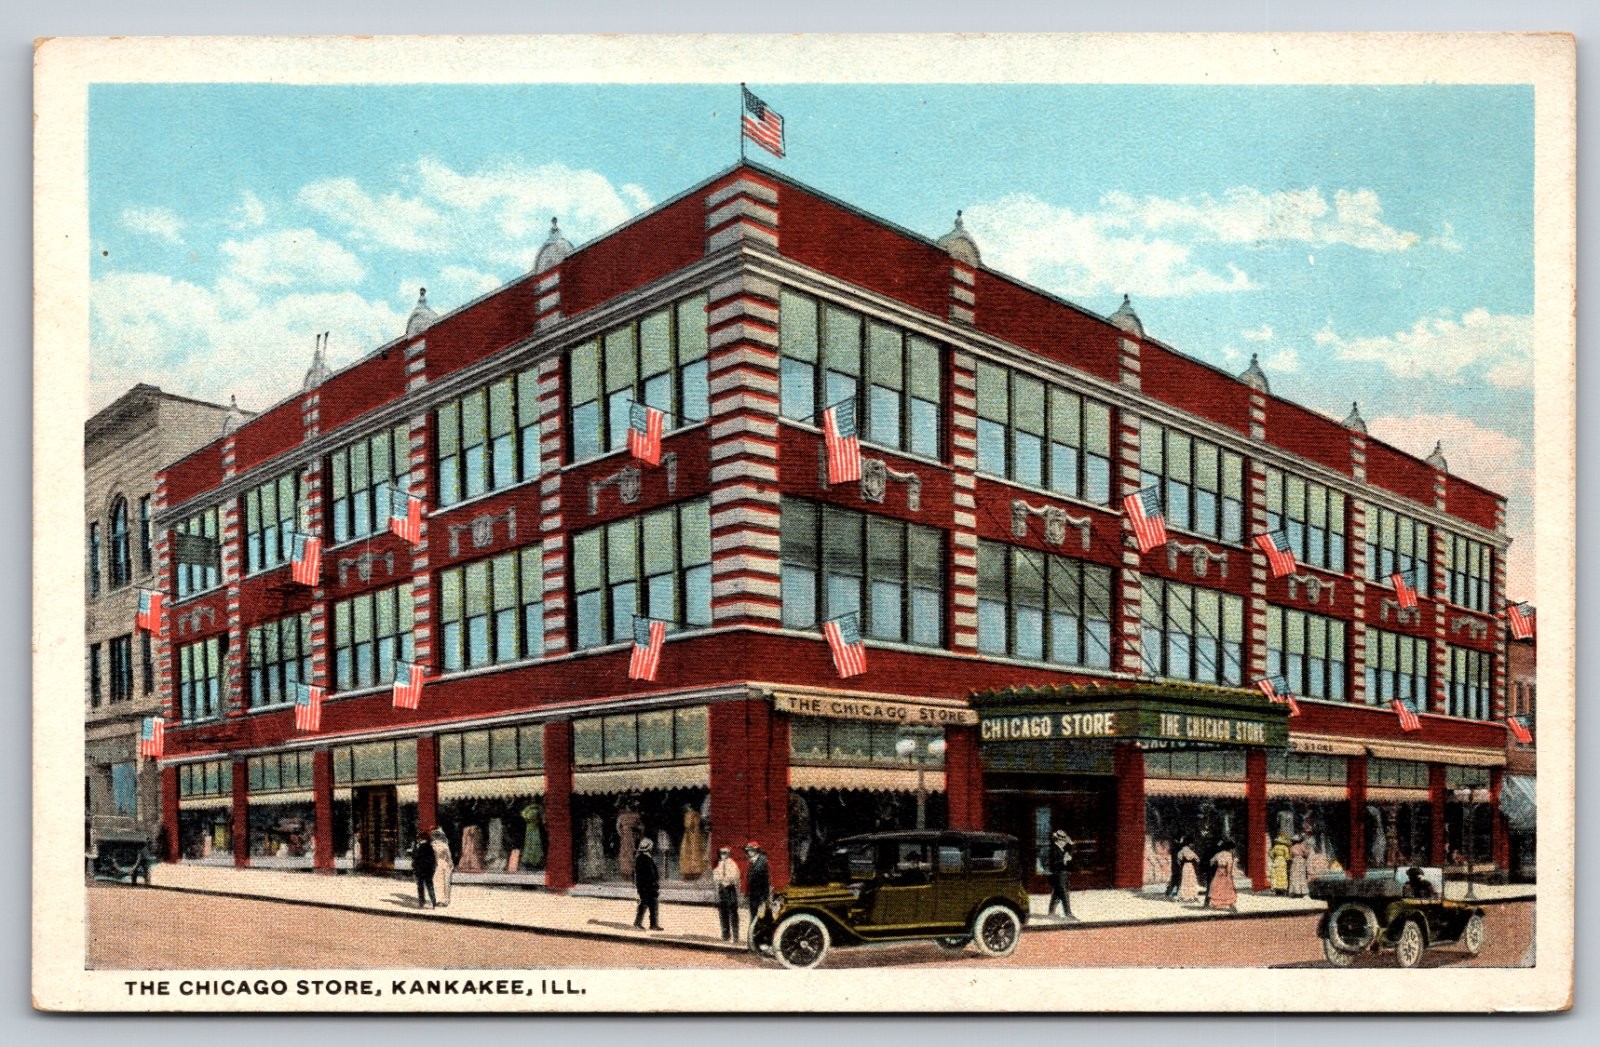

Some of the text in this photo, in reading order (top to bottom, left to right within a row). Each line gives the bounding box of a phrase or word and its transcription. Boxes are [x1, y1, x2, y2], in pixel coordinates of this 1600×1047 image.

[789, 697, 966, 722] THE CHICAGO STORE
[981, 712, 1115, 739] CHICAGO STORE
[1160, 713, 1265, 743] THE CHICAGO STORE
